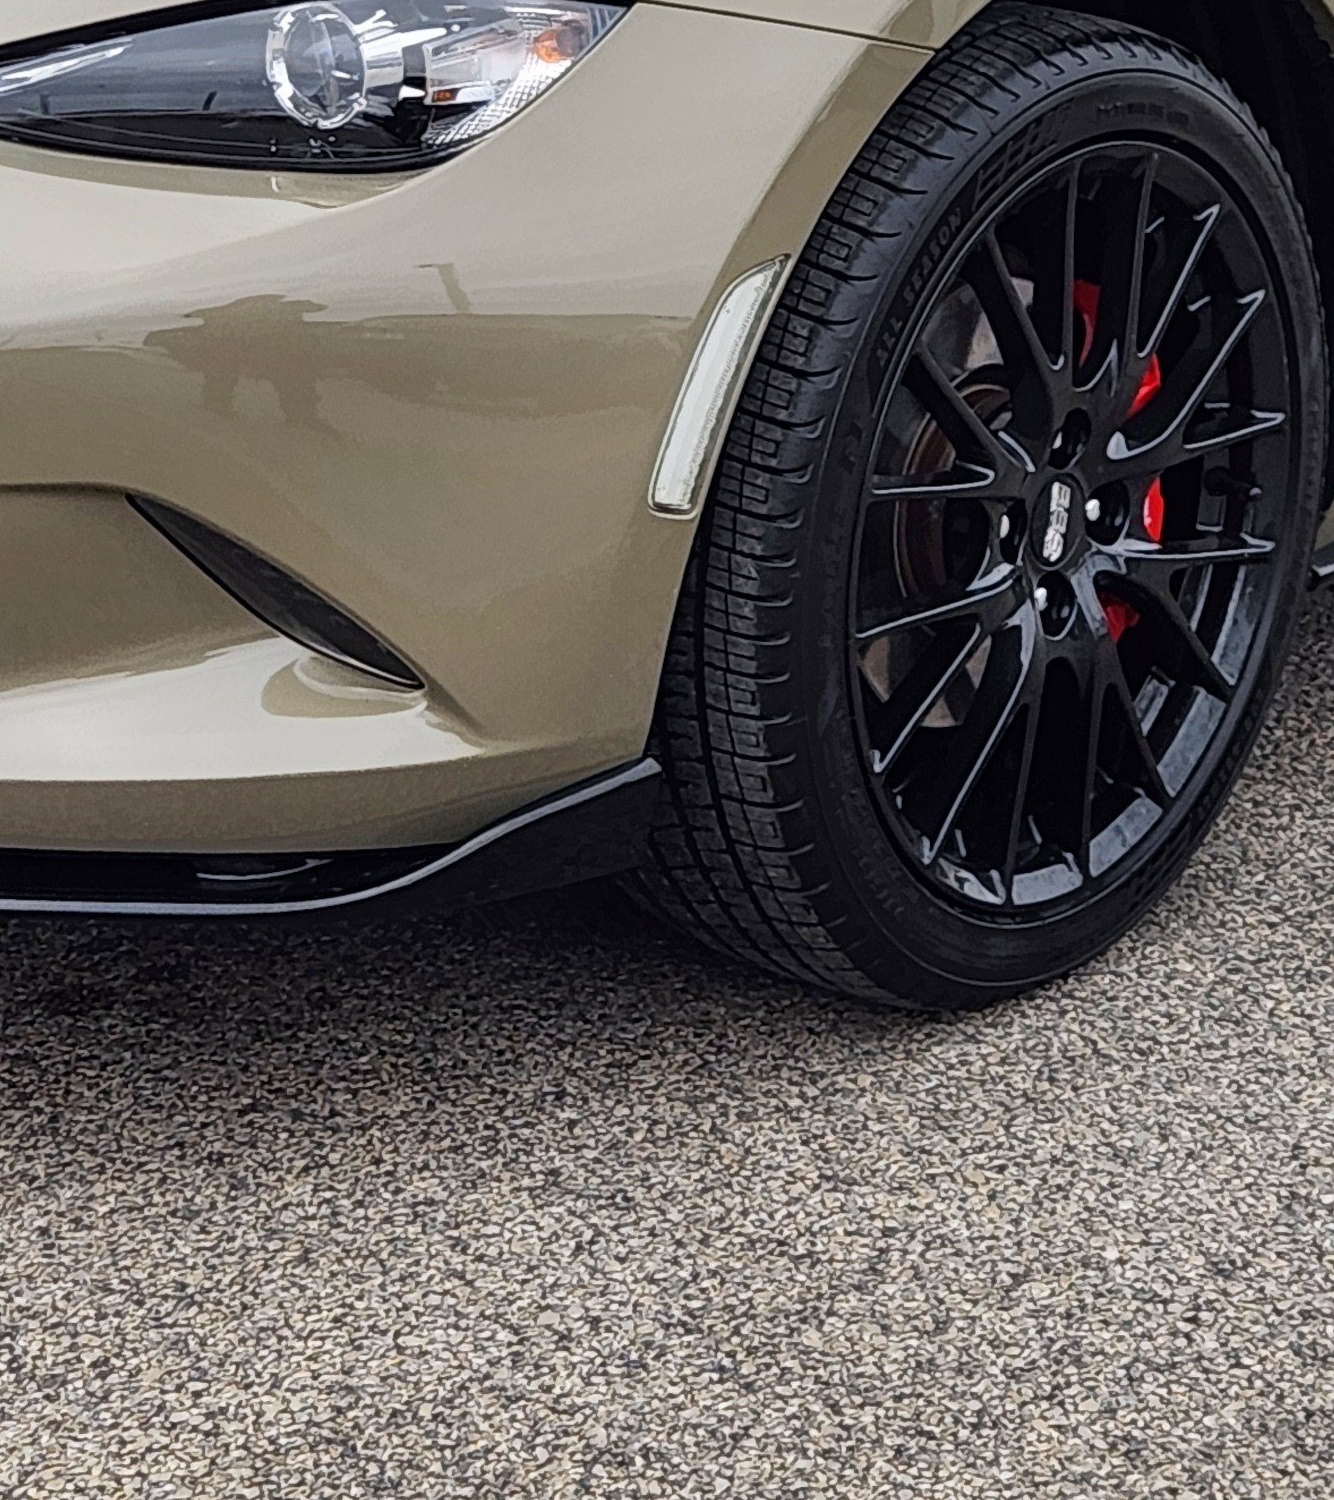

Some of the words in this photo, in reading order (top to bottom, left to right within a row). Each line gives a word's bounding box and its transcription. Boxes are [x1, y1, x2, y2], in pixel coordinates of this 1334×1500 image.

[875, 316, 903, 369] ALL
[903, 206, 962, 307] SEASON
[1042, 481, 1072, 562] BBS
